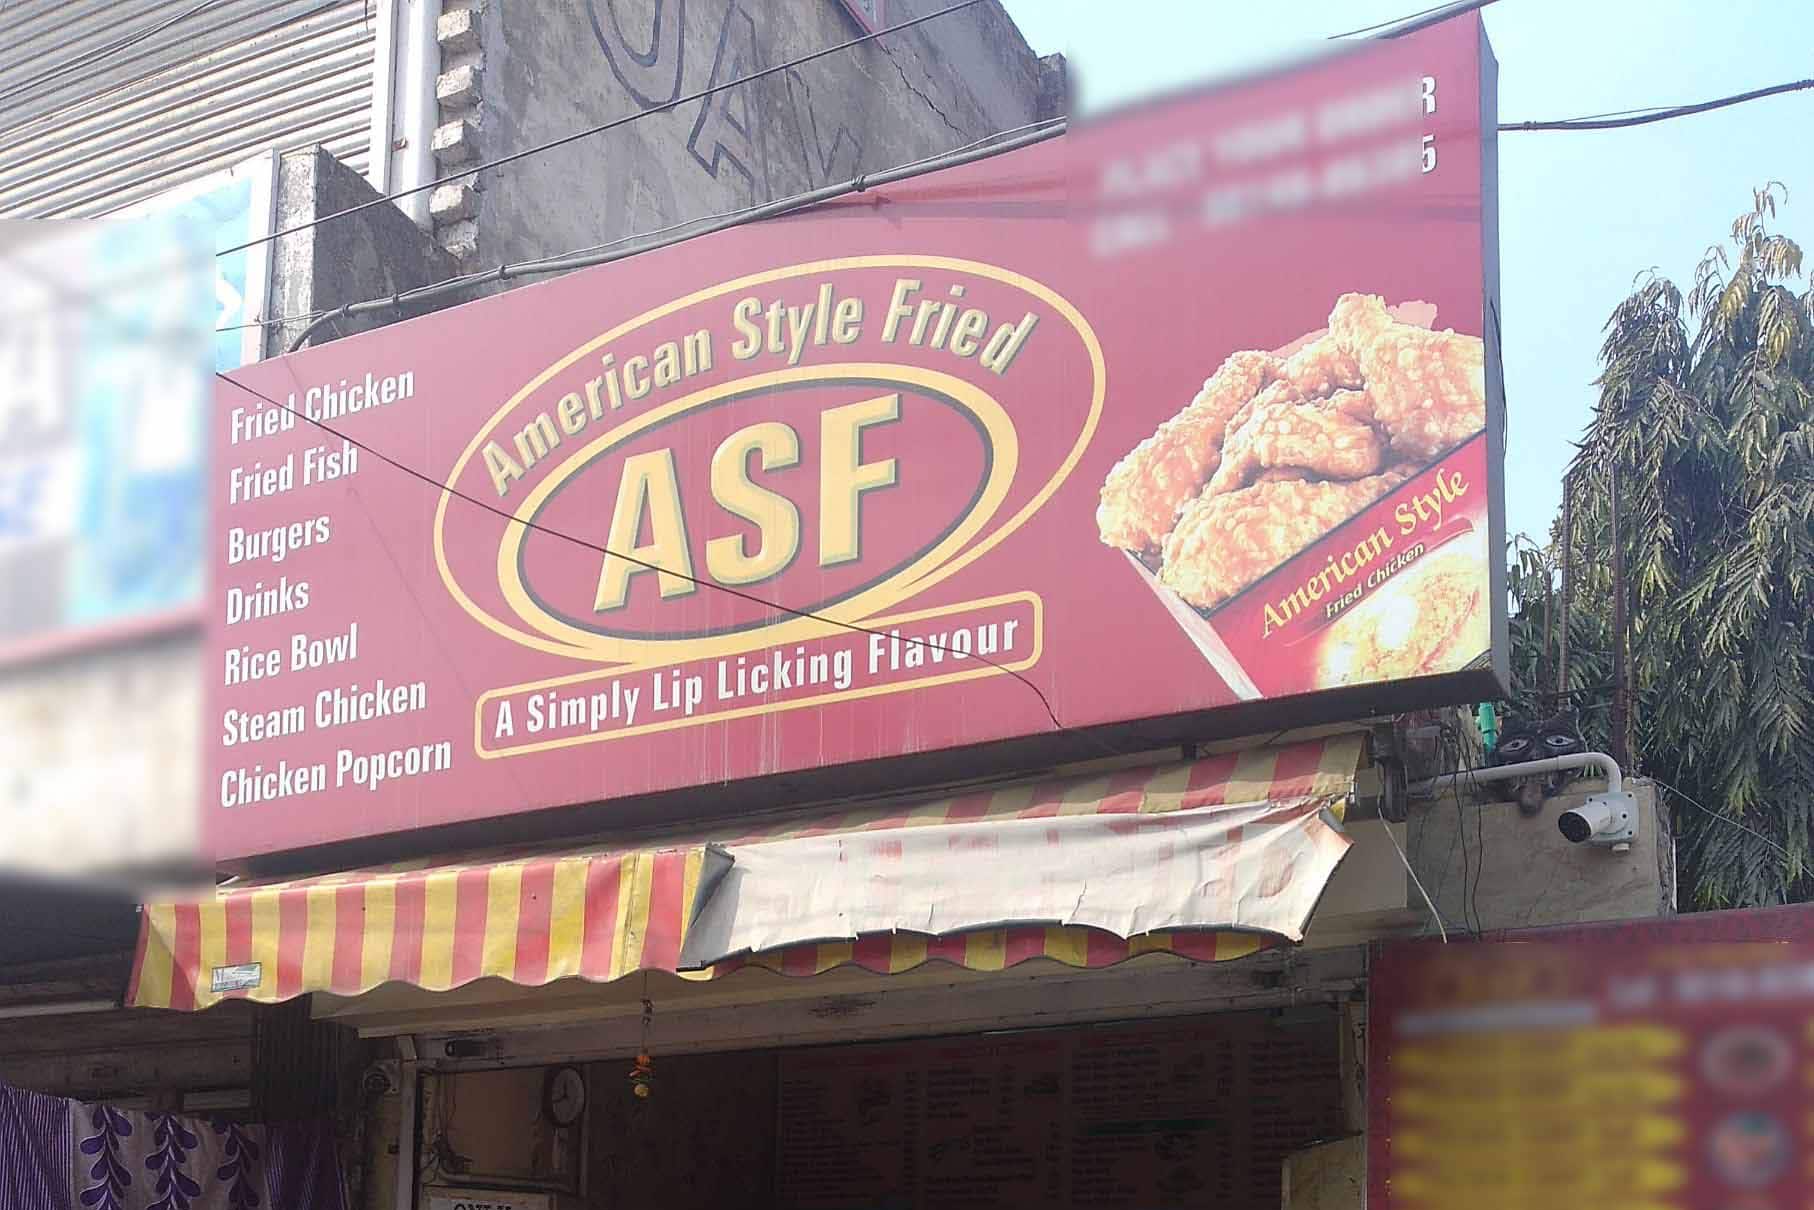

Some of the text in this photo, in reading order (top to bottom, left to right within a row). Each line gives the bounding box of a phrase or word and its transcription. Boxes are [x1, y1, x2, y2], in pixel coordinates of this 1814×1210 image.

[231, 370, 415, 445] Fried Chicken
[480, 278, 1039, 497] American Style Fried
[229, 439, 359, 505] Fried Fish
[592, 392, 902, 614] ASF
[227, 514, 331, 565] Burgers
[1261, 468, 1470, 640] American Style
[225, 575, 310, 626] Drinks
[1325, 542, 1425, 618] Fried Chicken
[223, 622, 359, 686] Rice Bowl
[494, 615, 1020, 738] A Simply Lip Licking Flavour
[222, 679, 427, 747] Steam Chicken
[220, 740, 452, 808] Chicken Popcorn
